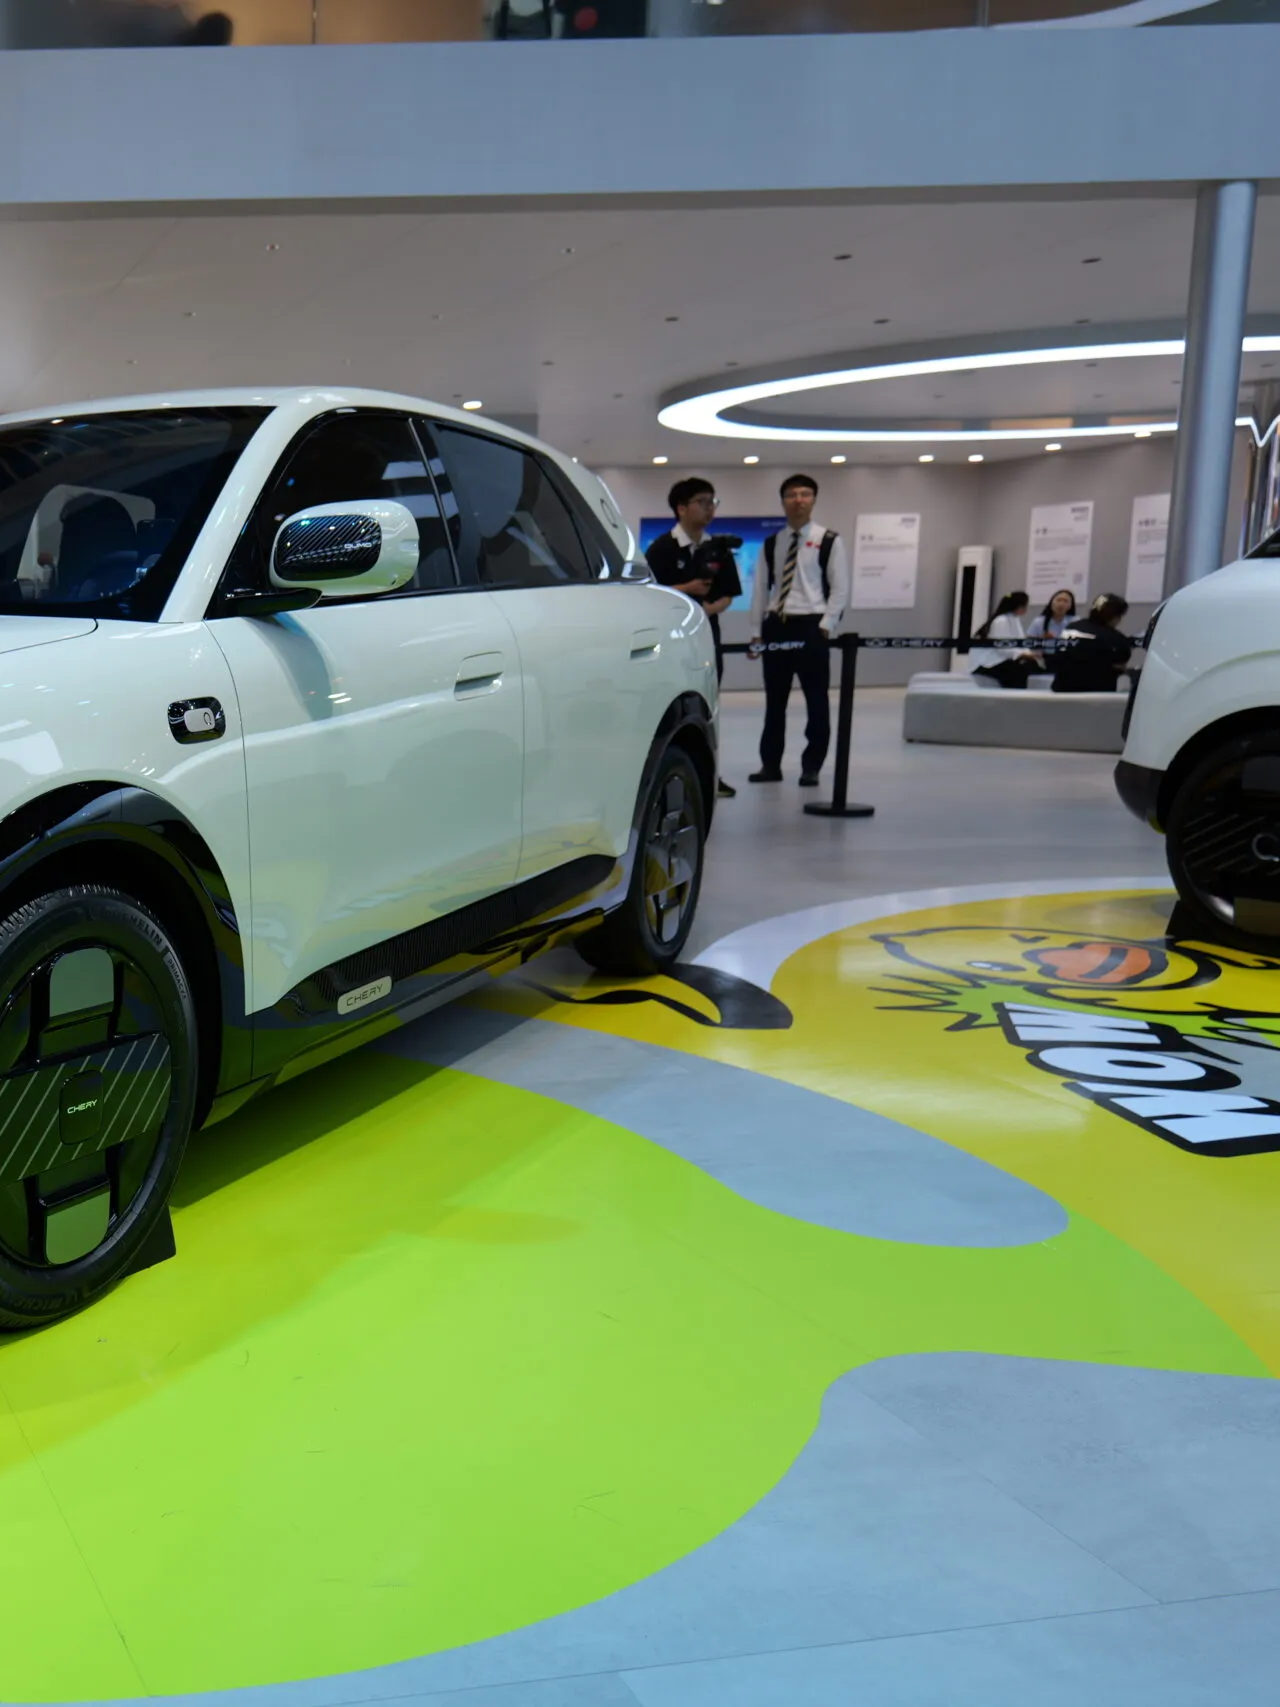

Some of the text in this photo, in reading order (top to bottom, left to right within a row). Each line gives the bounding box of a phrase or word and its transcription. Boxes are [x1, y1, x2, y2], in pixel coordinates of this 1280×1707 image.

[768, 640, 805, 651] CHERY
[892, 639, 944, 647] CHERY
[346, 984, 383, 1006] CHERY
[67, 1099, 98, 1114] CHERY
